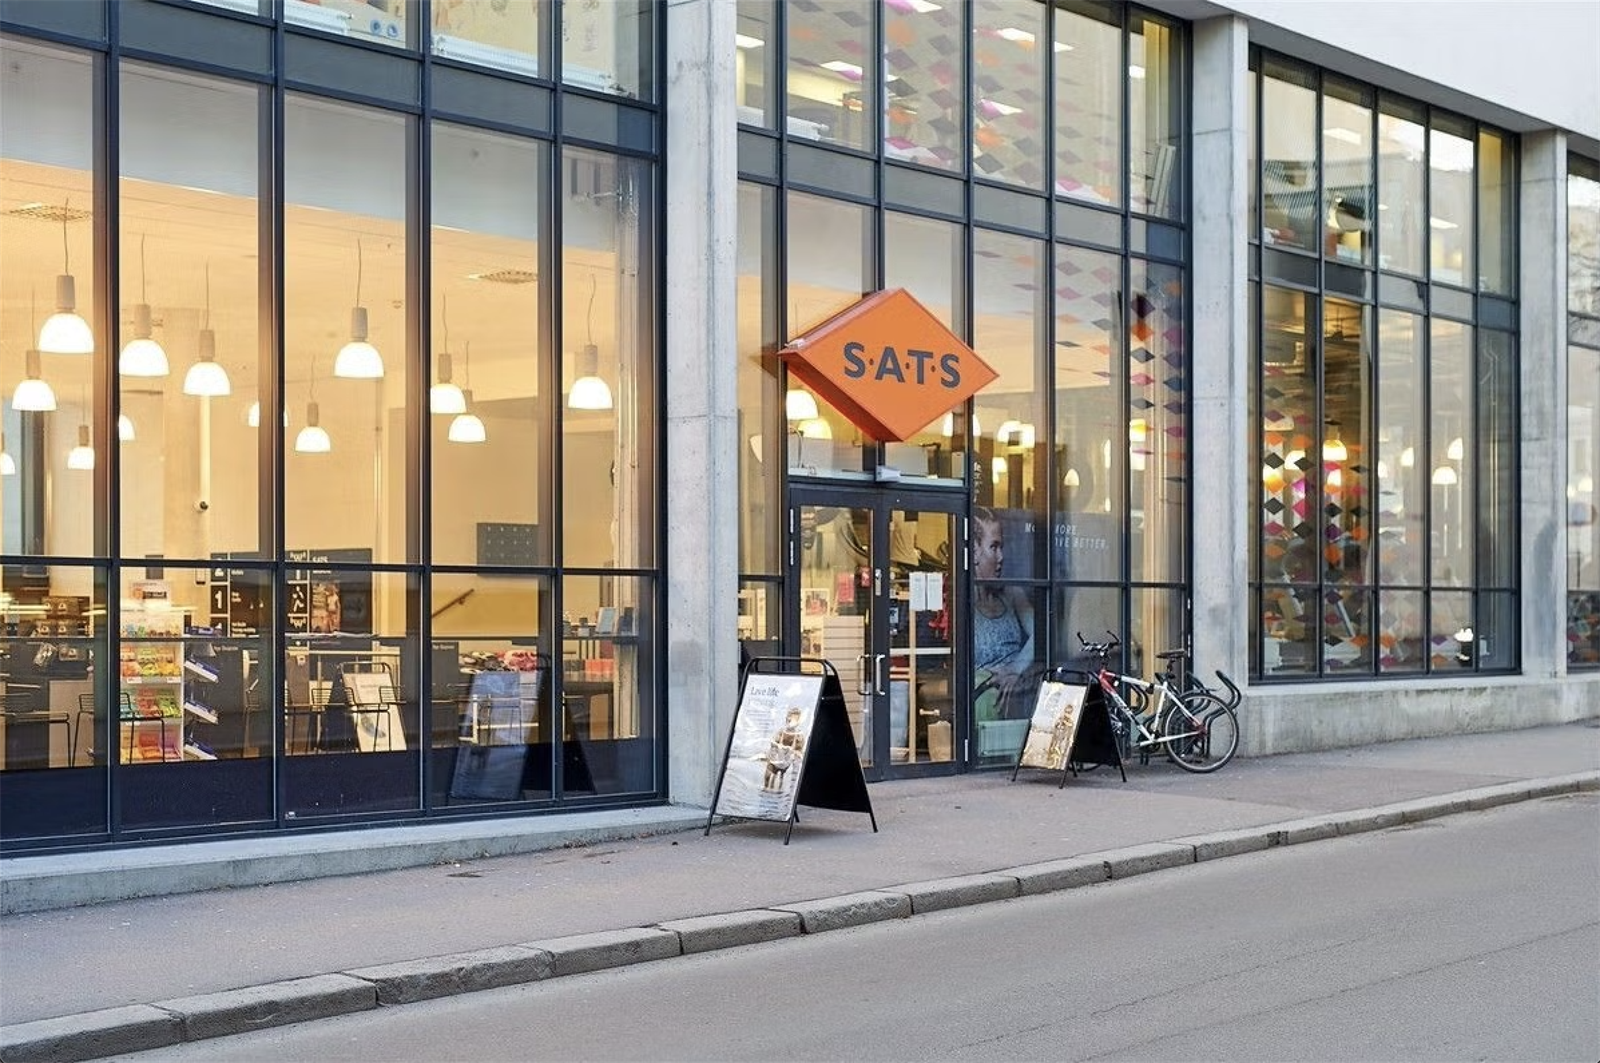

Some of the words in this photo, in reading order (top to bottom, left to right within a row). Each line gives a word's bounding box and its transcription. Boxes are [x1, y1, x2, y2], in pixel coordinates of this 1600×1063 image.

[215, 590, 222, 609] 1
[750, 686, 766, 696] Love
[767, 687, 780, 697] life
